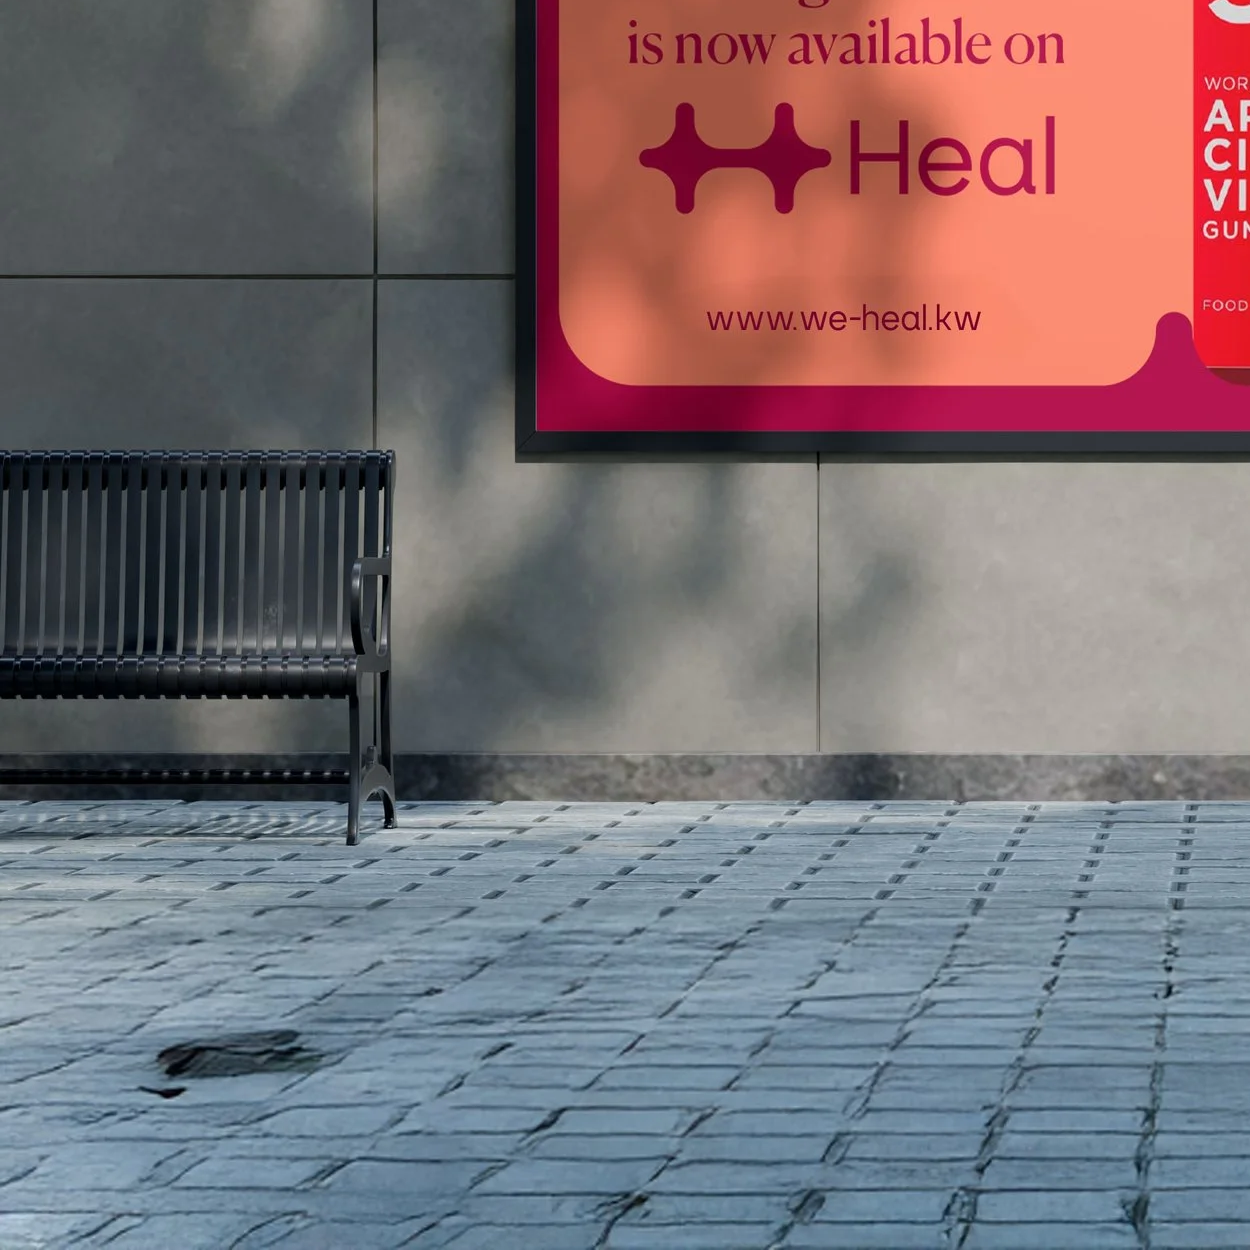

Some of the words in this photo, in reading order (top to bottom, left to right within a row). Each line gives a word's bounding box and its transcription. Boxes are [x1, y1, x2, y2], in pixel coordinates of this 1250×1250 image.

[627, 18, 664, 65] is
[675, 31, 776, 65] now
[787, 17, 992, 65] available
[1003, 31, 1065, 65] on
[849, 116, 1056, 196] Heal
[705, 303, 982, 332] www.we-heal.kw
[1203, 299, 1249, 312] FOOD
